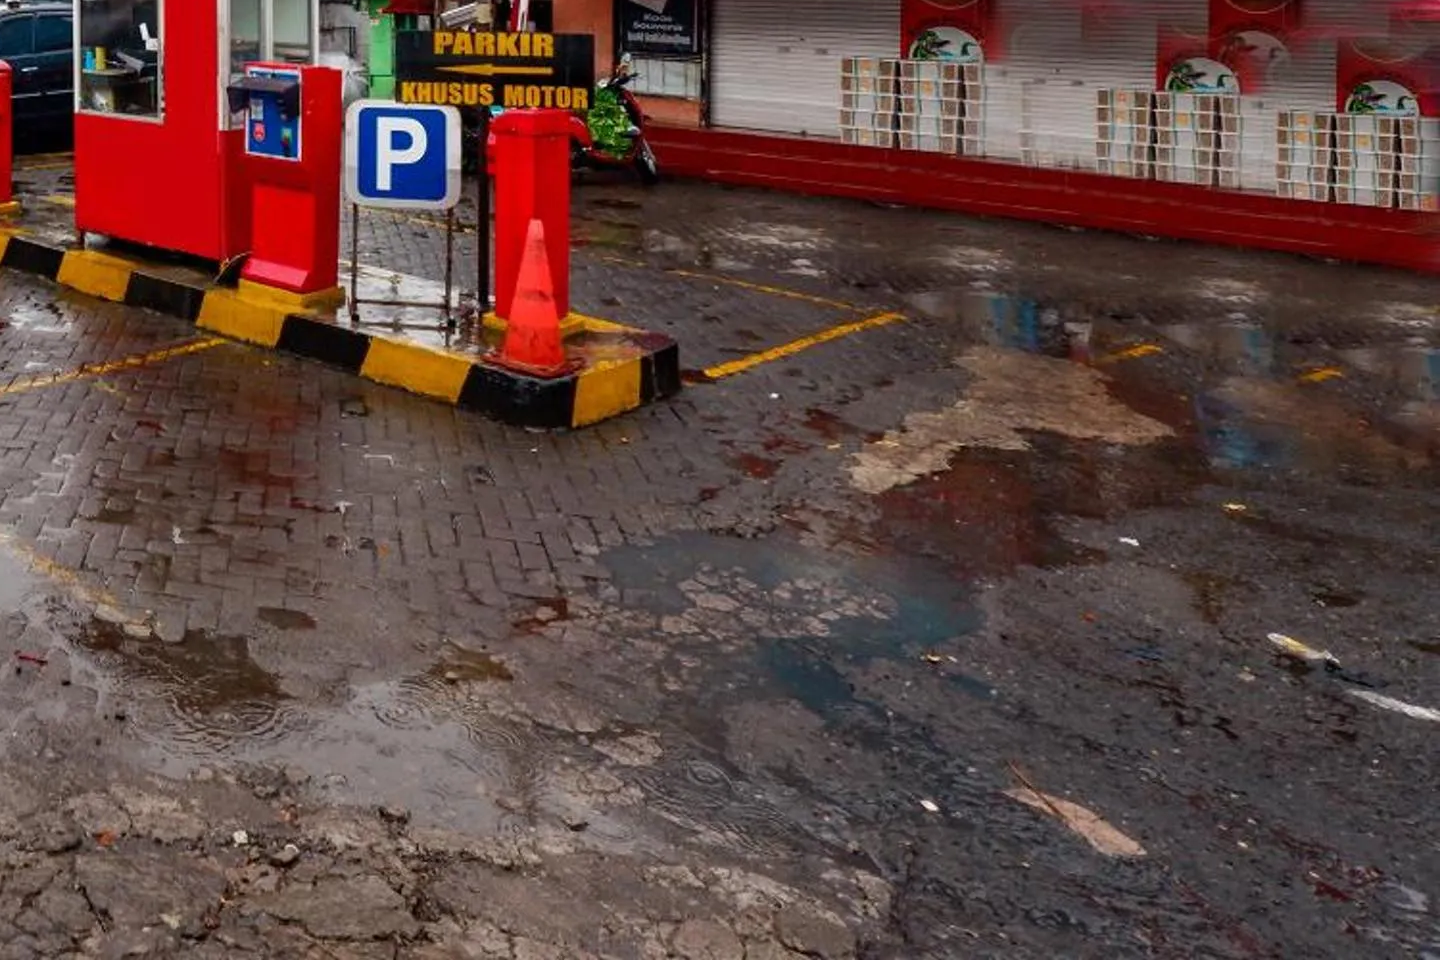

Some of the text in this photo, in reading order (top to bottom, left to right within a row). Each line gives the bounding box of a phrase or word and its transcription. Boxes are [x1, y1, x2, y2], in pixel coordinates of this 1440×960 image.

[433, 31, 555, 57] PARKIR
[401, 80, 589, 109] KHUSUS MOTOR
[375, 116, 428, 191] P
